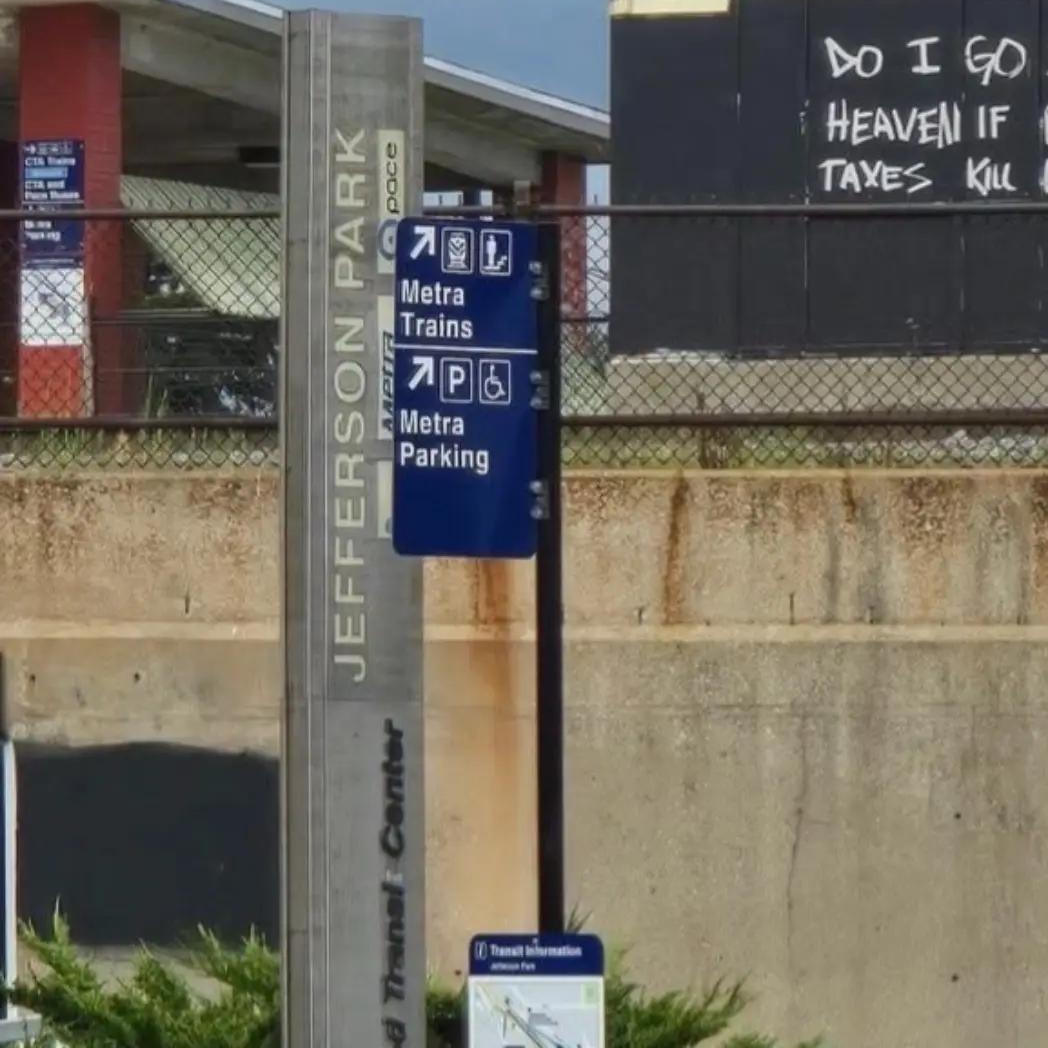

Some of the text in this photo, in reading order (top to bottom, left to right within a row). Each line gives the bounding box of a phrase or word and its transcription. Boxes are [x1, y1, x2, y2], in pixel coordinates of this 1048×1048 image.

[824, 36, 883, 78] DO
[906, 36, 941, 73] I
[964, 35, 1026, 86] GO
[826, 99, 961, 149] HEAVEN
[977, 105, 1010, 139] IF
[386, 141, 400, 214] pace
[818, 158, 933, 193] TAXES
[401, 279, 465, 306] Metra
[400, 312, 473, 339] Trains
[334, 128, 366, 683] JEFFERSON PARK
[400, 409, 465, 435] Metra
[400, 441, 489, 475] Parking
[379, 718, 405, 857] Center
